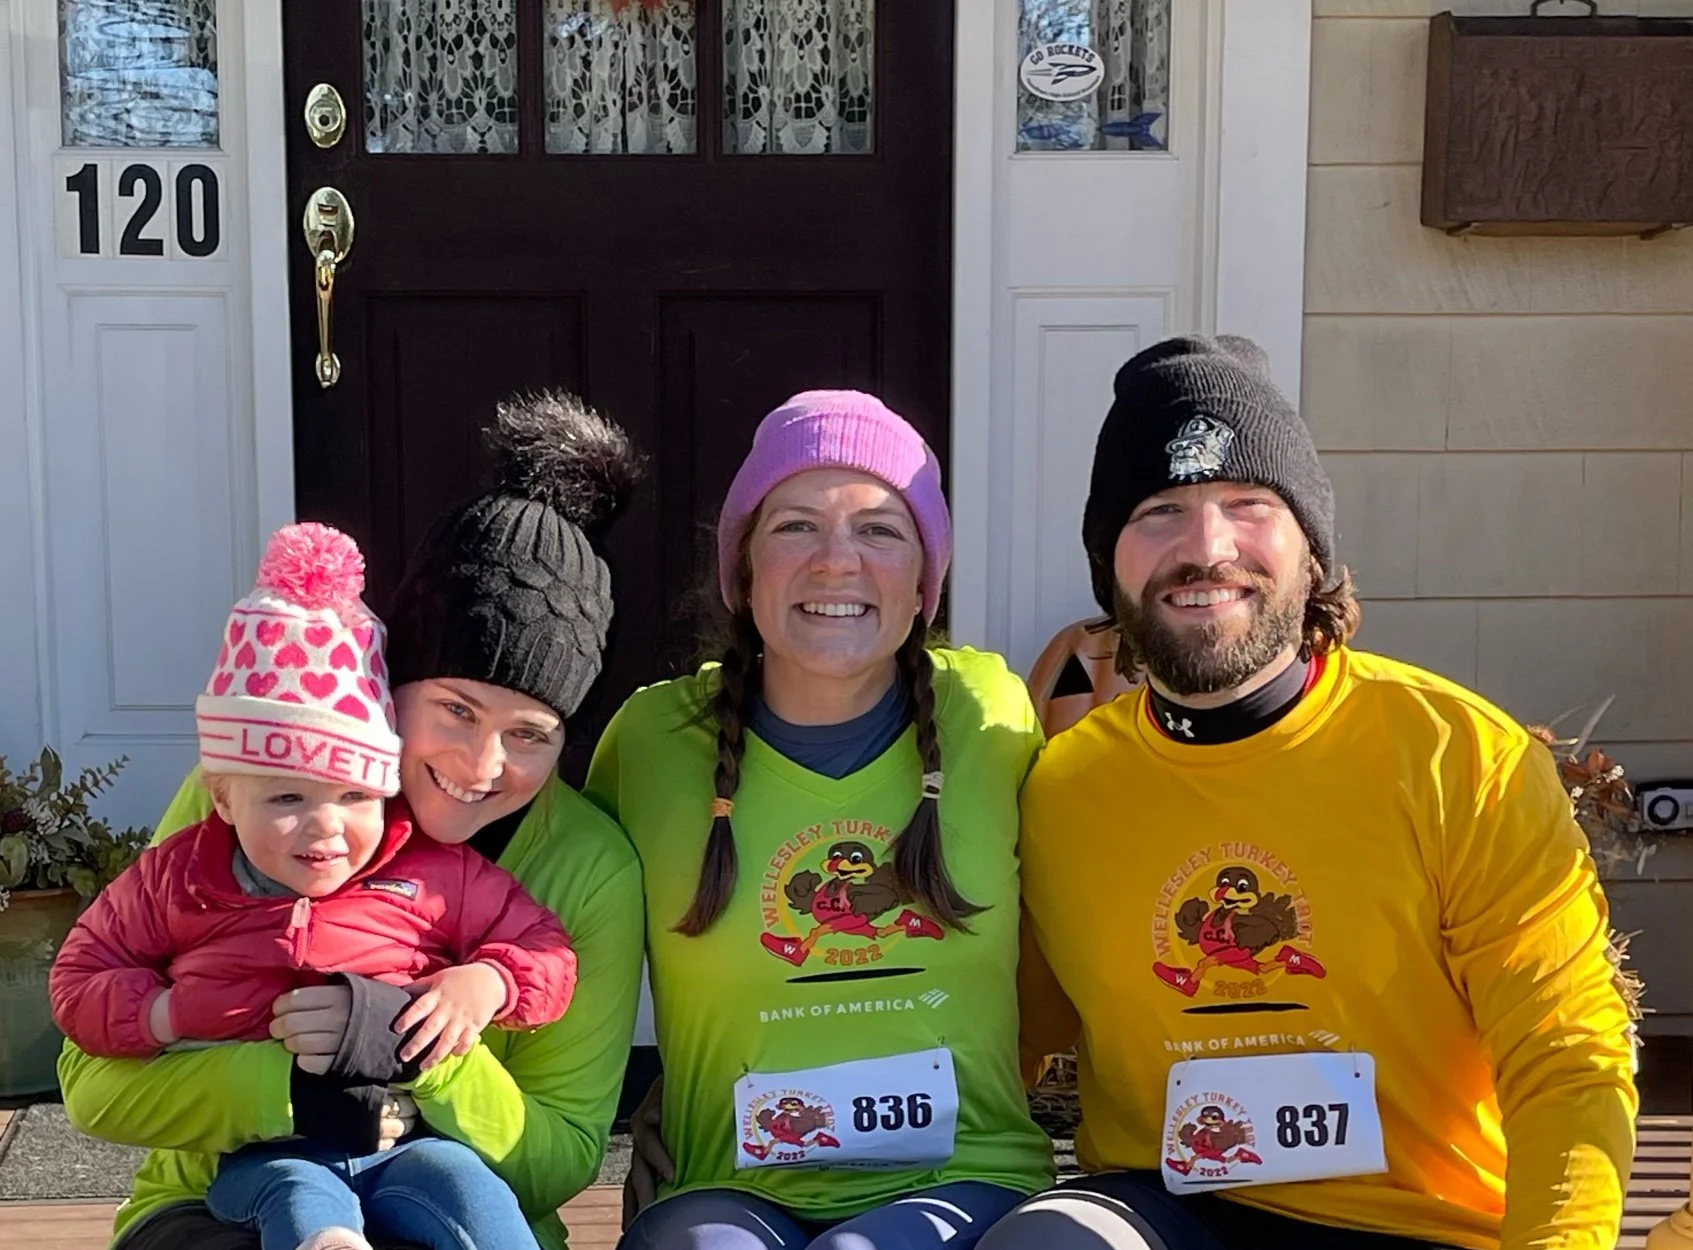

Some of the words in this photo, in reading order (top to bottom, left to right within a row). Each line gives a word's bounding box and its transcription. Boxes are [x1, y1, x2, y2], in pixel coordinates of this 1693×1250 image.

[1029, 50, 1044, 66] GO
[1046, 44, 1096, 63] ROCKETS
[66, 163, 220, 257] 120
[240, 728, 392, 787] LOVETT
[761, 824, 823, 928] WELLESLEY
[832, 819, 895, 847] TURK
[1153, 847, 1213, 958] WELLESLEY
[1220, 842, 1298, 887] TURKEY
[1293, 888, 1313, 948] TROT
[908, 917, 921, 929] M
[783, 944, 796, 955] W
[825, 944, 884, 966] 2022
[1289, 954, 1301, 965] M
[1175, 974, 1187, 986] W
[1213, 980, 1268, 998] 2022
[759, 1007, 805, 1023] BANK
[810, 1004, 831, 1017] OF
[836, 998, 915, 1015] AMERICA
[1163, 1040, 1204, 1053] BANK
[1208, 1038, 1229, 1050] OF
[1234, 1033, 1305, 1048] AMERICA
[852, 1093, 933, 1133] 836
[1202, 1091, 1247, 1116] TURKEY
[1275, 1103, 1349, 1149] 837
[776, 1150, 807, 1161] 2022
[1199, 1166, 1229, 1177] 2022
